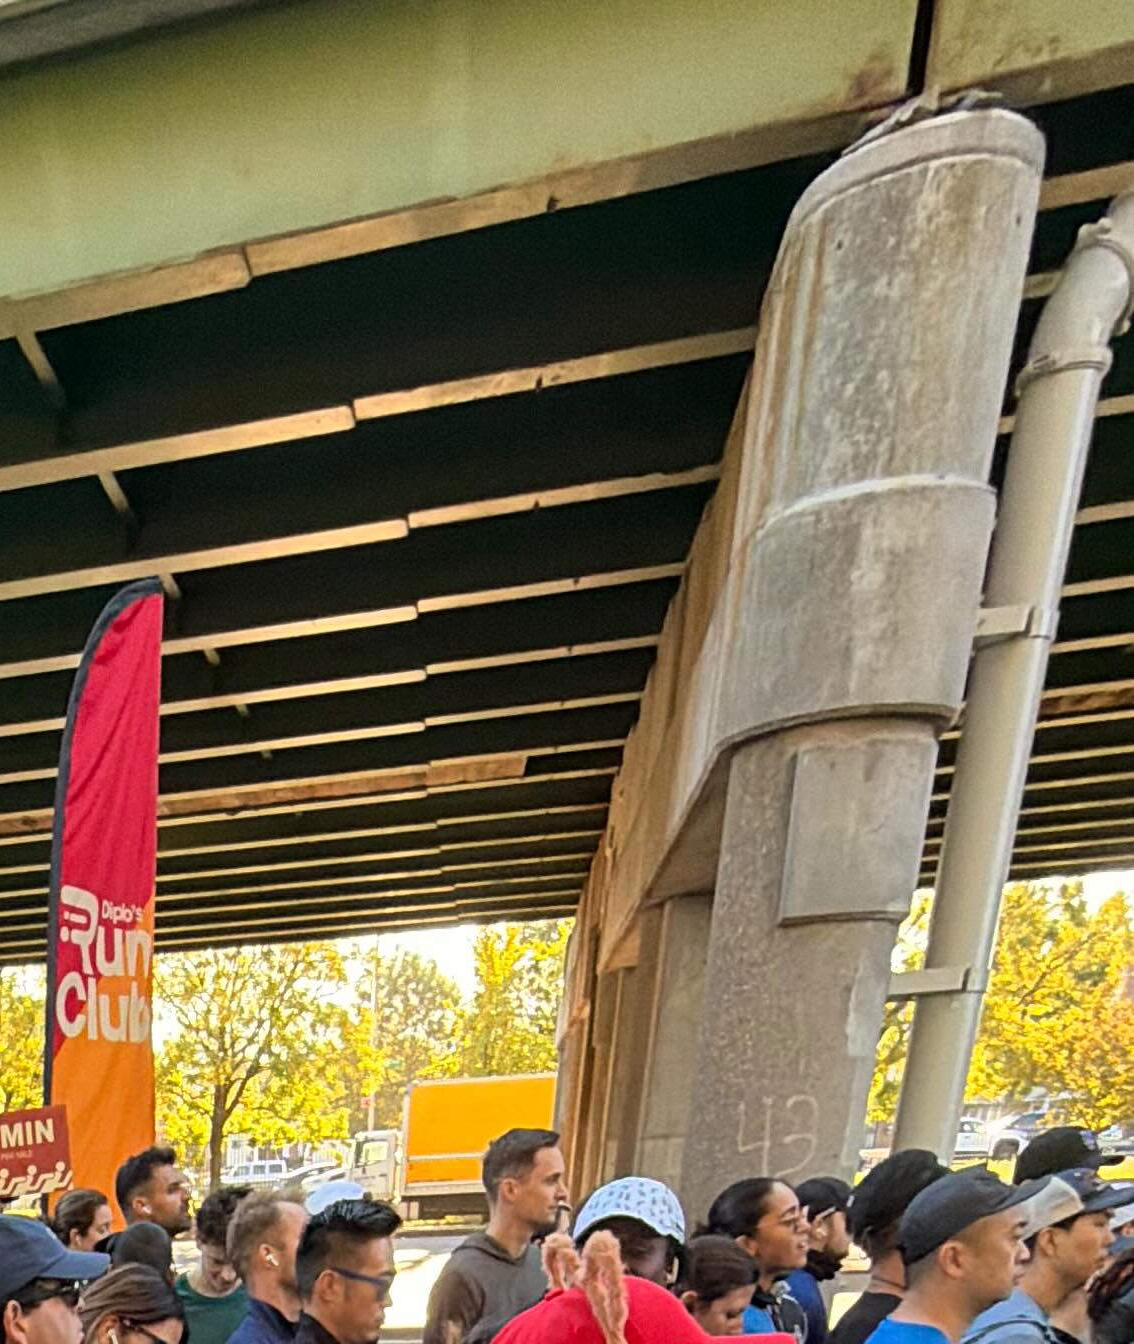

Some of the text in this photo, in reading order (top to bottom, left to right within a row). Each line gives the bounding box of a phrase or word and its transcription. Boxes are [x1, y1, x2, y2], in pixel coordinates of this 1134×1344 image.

[60, 885, 153, 977] Run
[101, 899, 143, 923] Diplo's
[56, 971, 152, 1043] Club
[0, 1118, 54, 1148] MIN
[737, 1094, 818, 1178] 43
